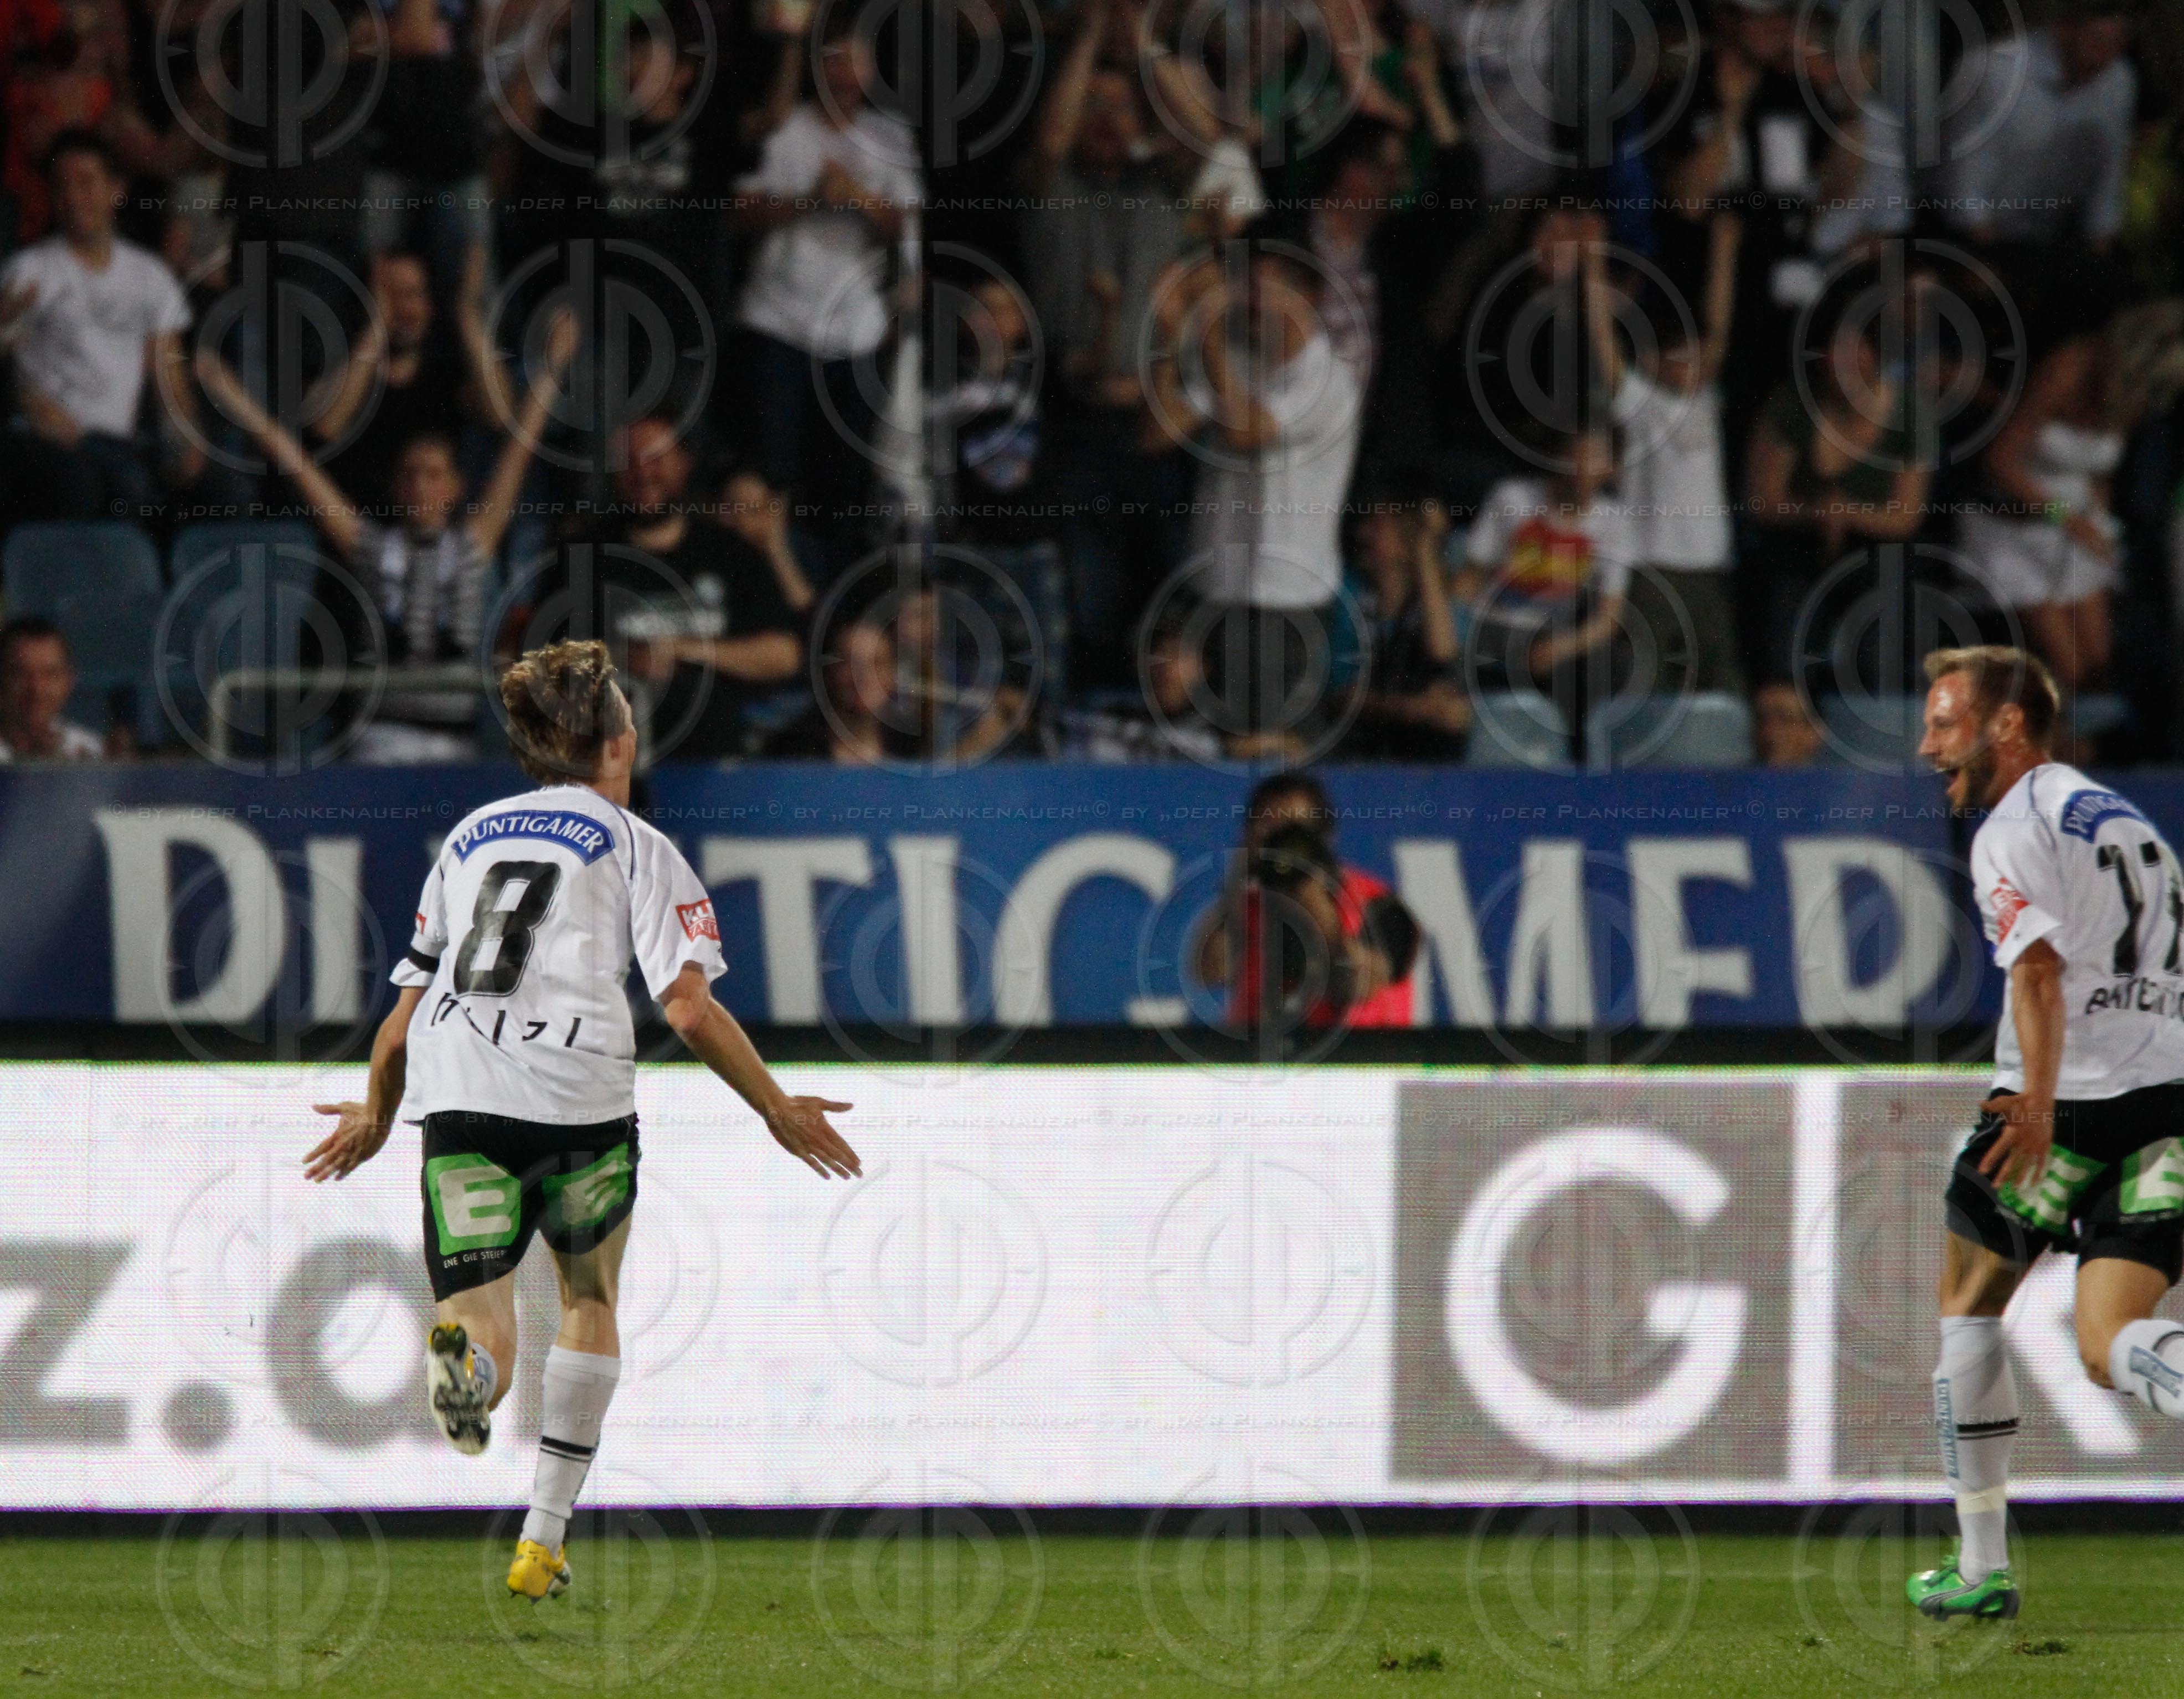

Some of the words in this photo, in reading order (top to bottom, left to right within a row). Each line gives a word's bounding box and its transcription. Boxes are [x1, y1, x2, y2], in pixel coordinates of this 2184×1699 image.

[457, 816, 604, 853] PUNTIGAMER
[452, 860, 562, 998] 8
[438, 1166, 512, 1238] E
[1445, 1125, 1749, 1463] G
